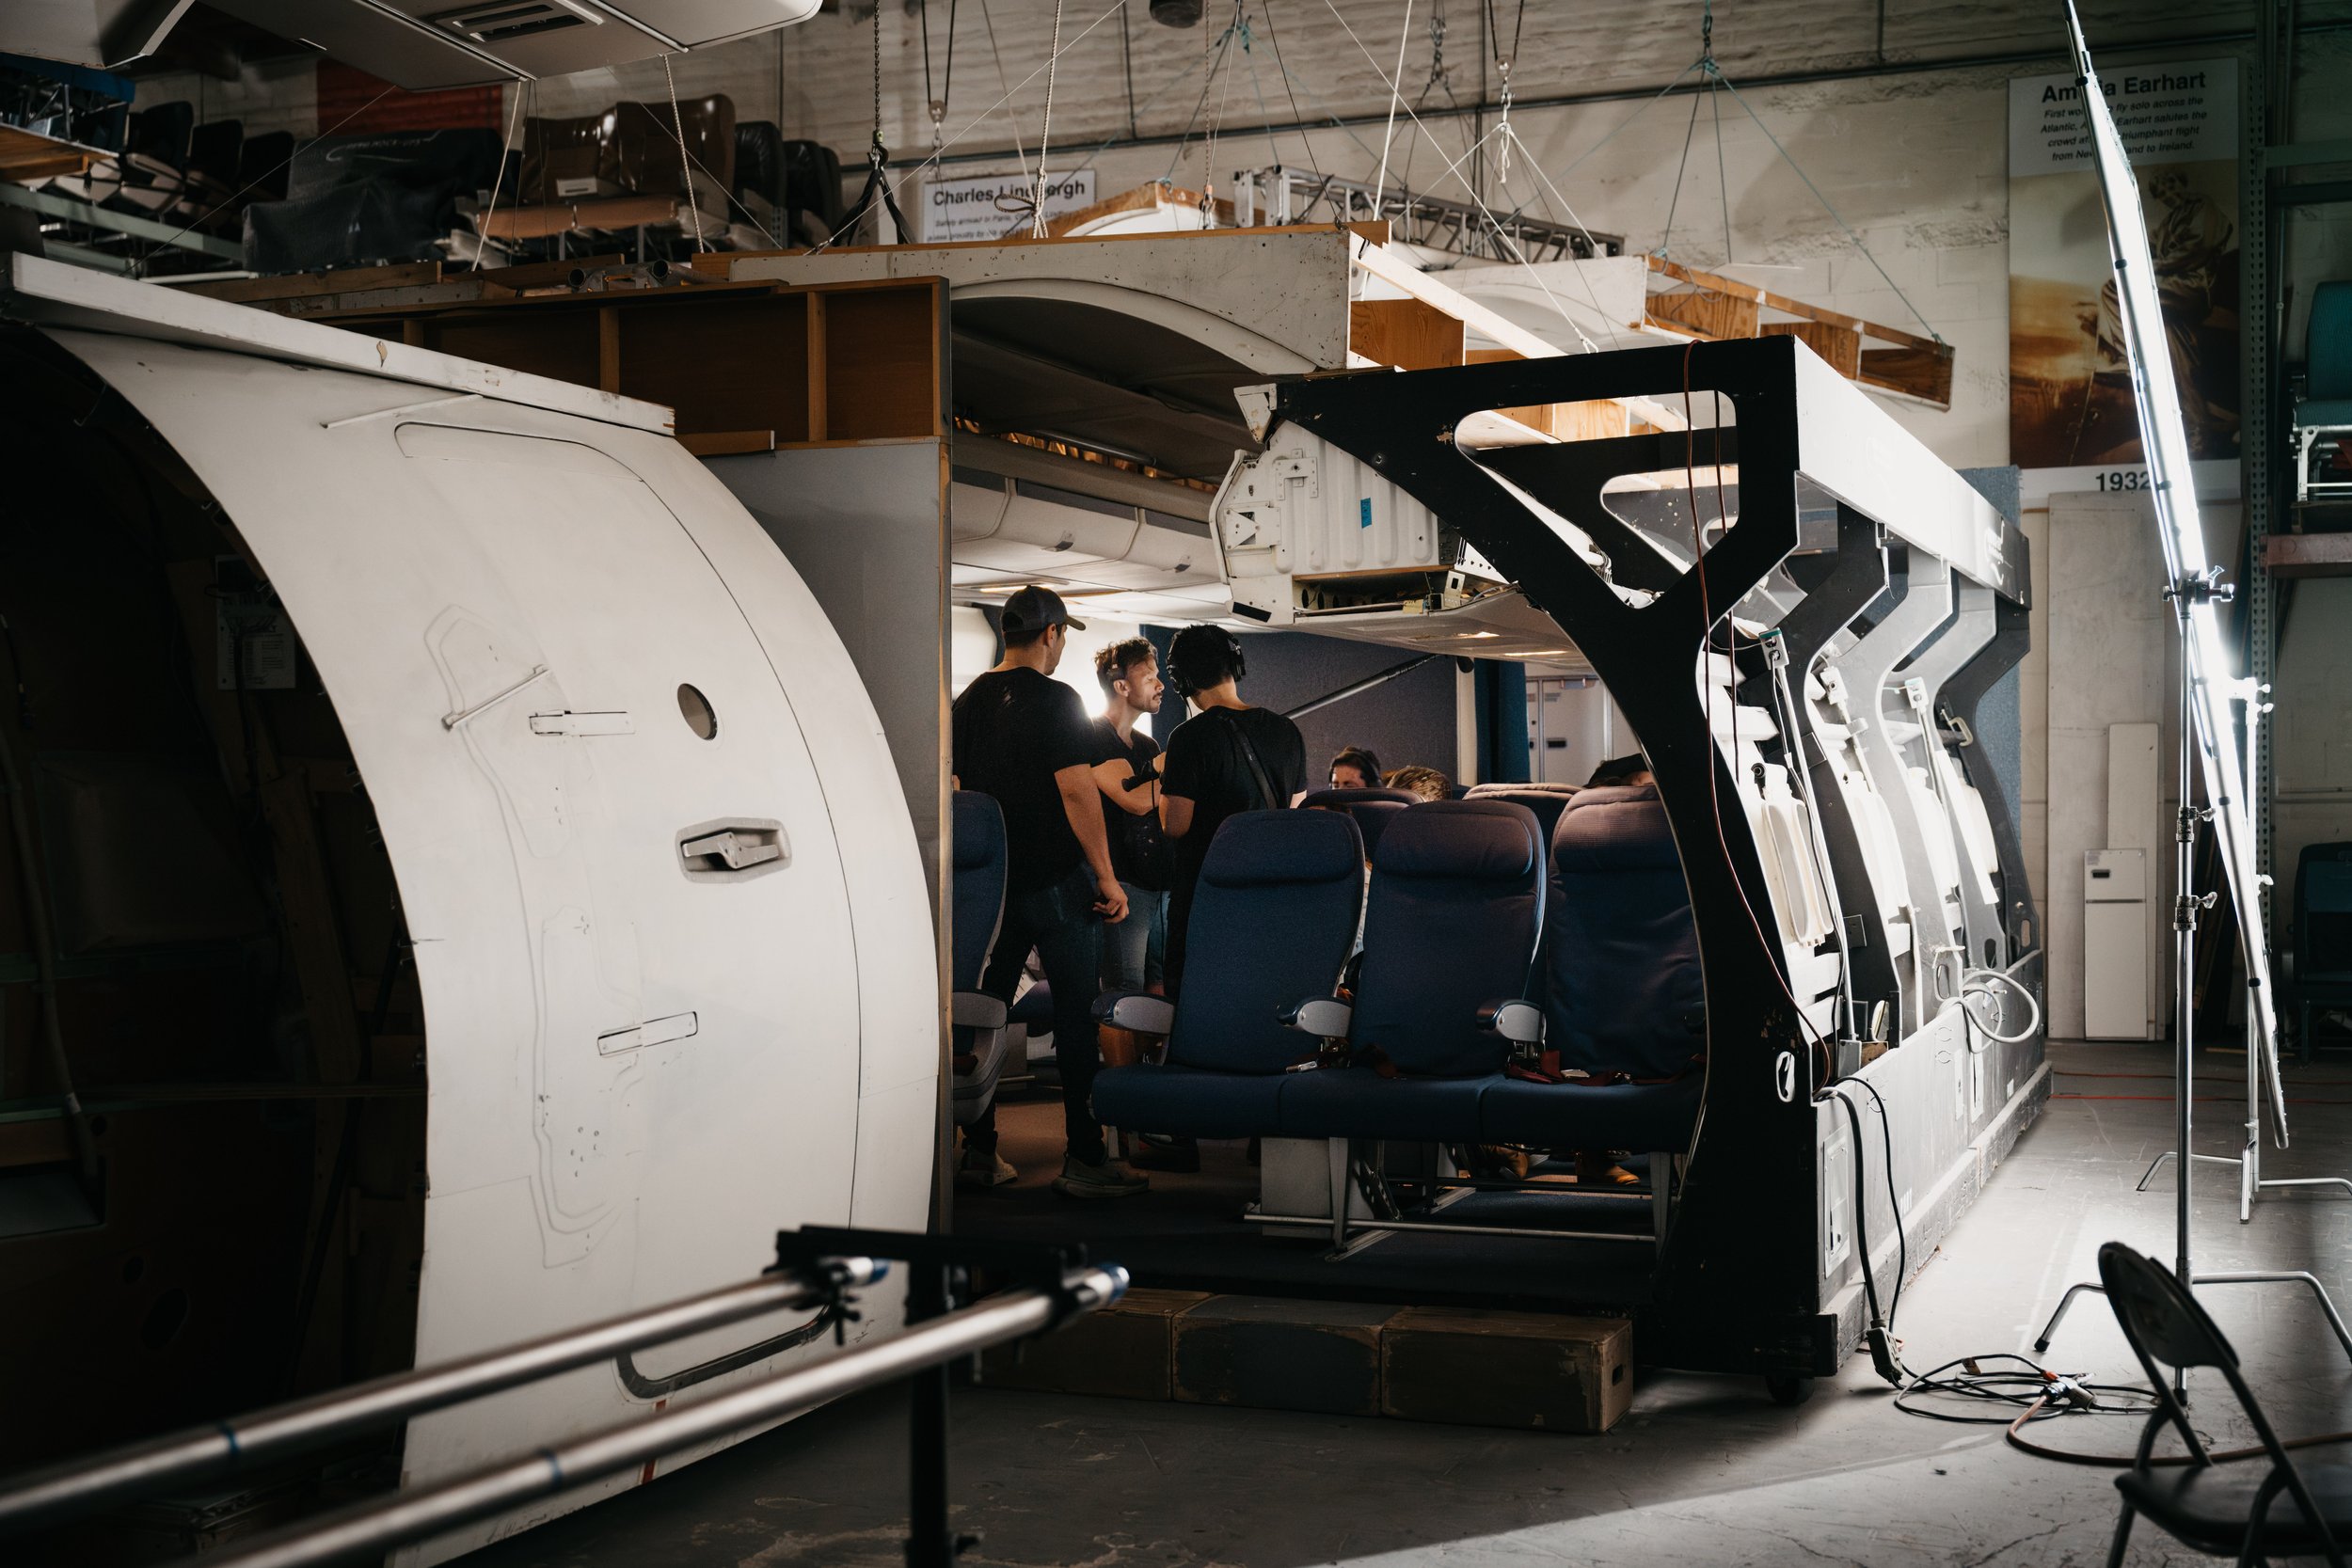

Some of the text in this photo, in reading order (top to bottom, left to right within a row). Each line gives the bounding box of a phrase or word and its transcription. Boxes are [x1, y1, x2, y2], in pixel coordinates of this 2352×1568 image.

[2042, 71, 2205, 103] Amia Earhart
[2044, 109, 2066, 119] First
[2130, 101, 2151, 111] solo
[2153, 98, 2186, 109] across
[2188, 96, 2204, 106] the
[2041, 122, 2078, 134] Atlantic,
[2116, 116, 2152, 126] Earhart
[2154, 112, 2189, 123] salutes
[2192, 110, 2208, 120] the
[2047, 136, 2077, 148] crowd
[2122, 128, 2173, 140] triumphant
[2176, 124, 2200, 137] flight
[2052, 151, 2074, 162] from
[2147, 143, 2156, 153] to
[933, 180, 1085, 206] Charles Lindergh
[2095, 470, 2152, 492] 1932
